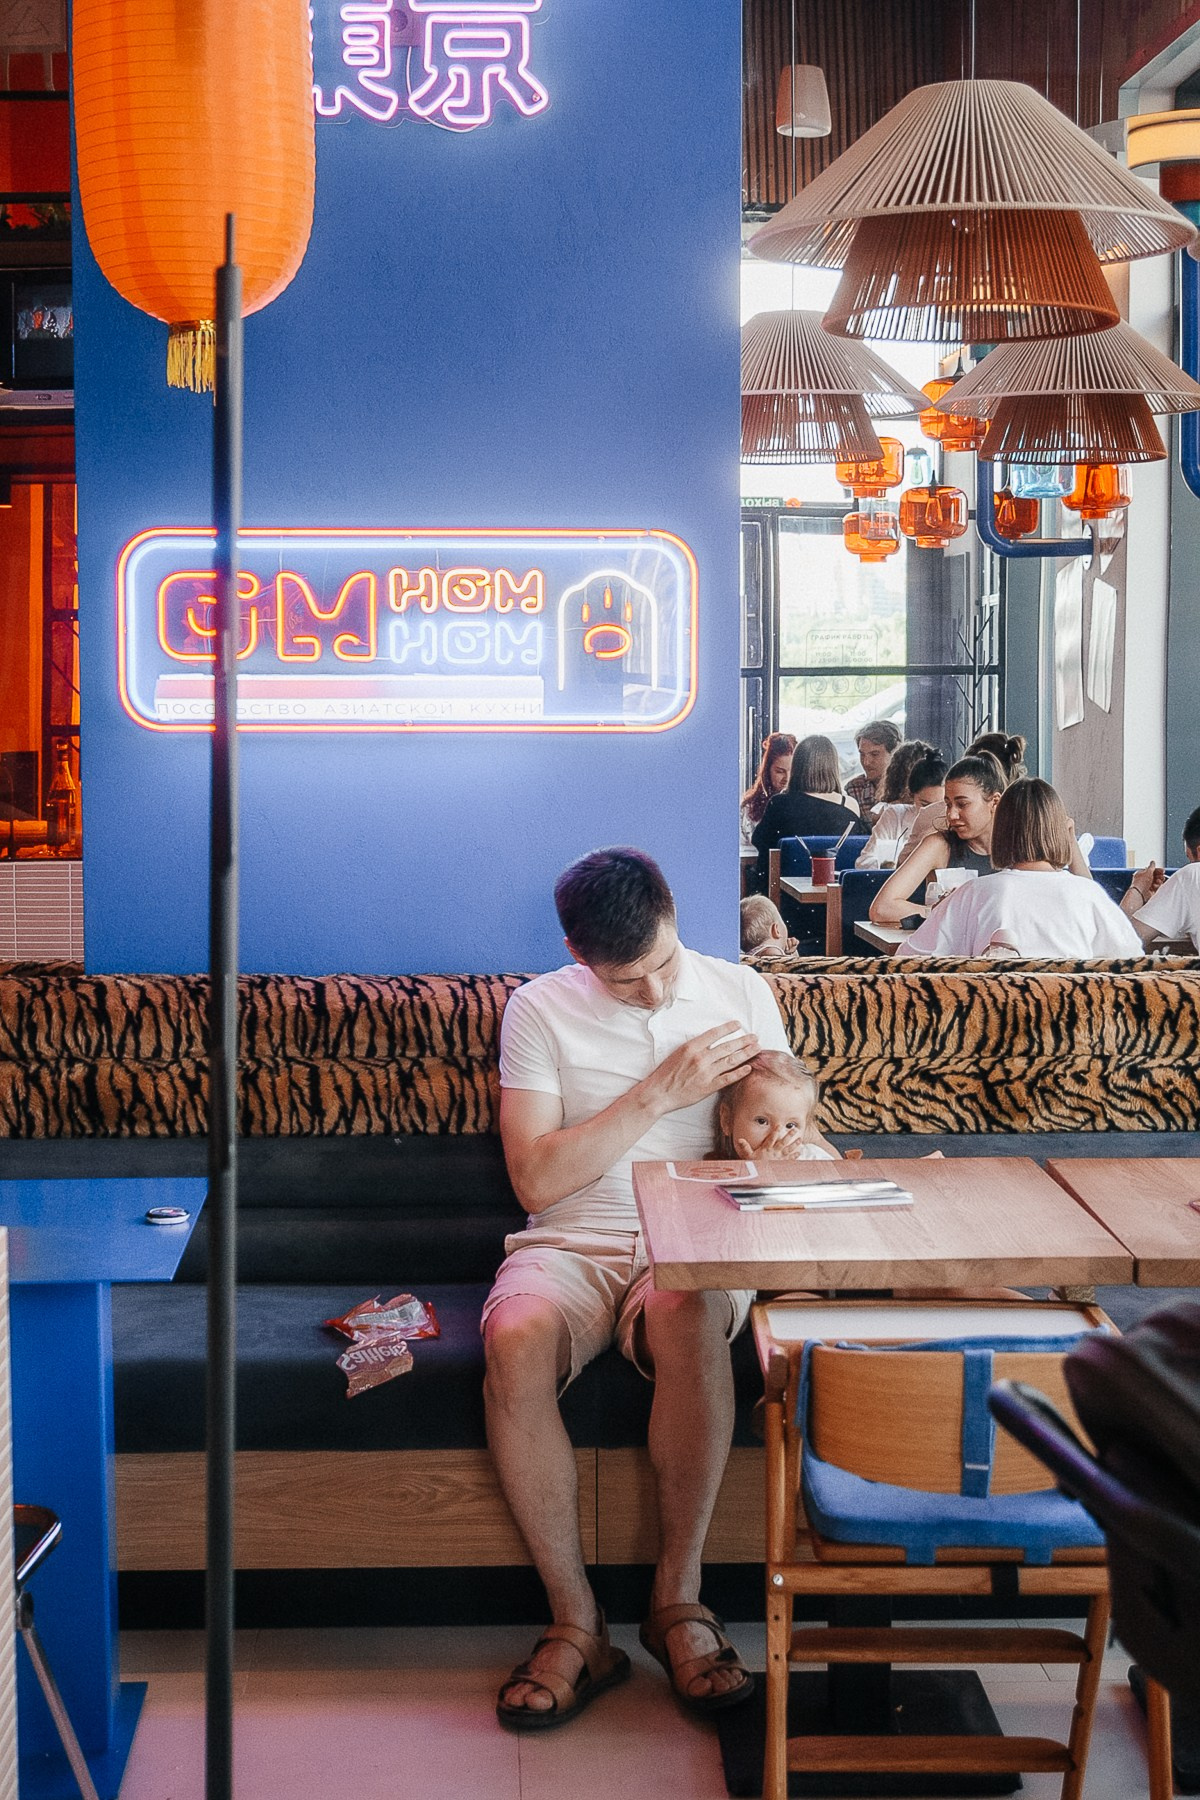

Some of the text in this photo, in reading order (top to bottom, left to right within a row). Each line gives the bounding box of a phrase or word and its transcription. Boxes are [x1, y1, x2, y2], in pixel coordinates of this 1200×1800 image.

[388, 566, 544, 613] НОМ
[388, 620, 544, 665] НОМ
[157, 701, 542, 715] ПОСОЬСТВО АЗИАТСКОЙ КУХНИ
